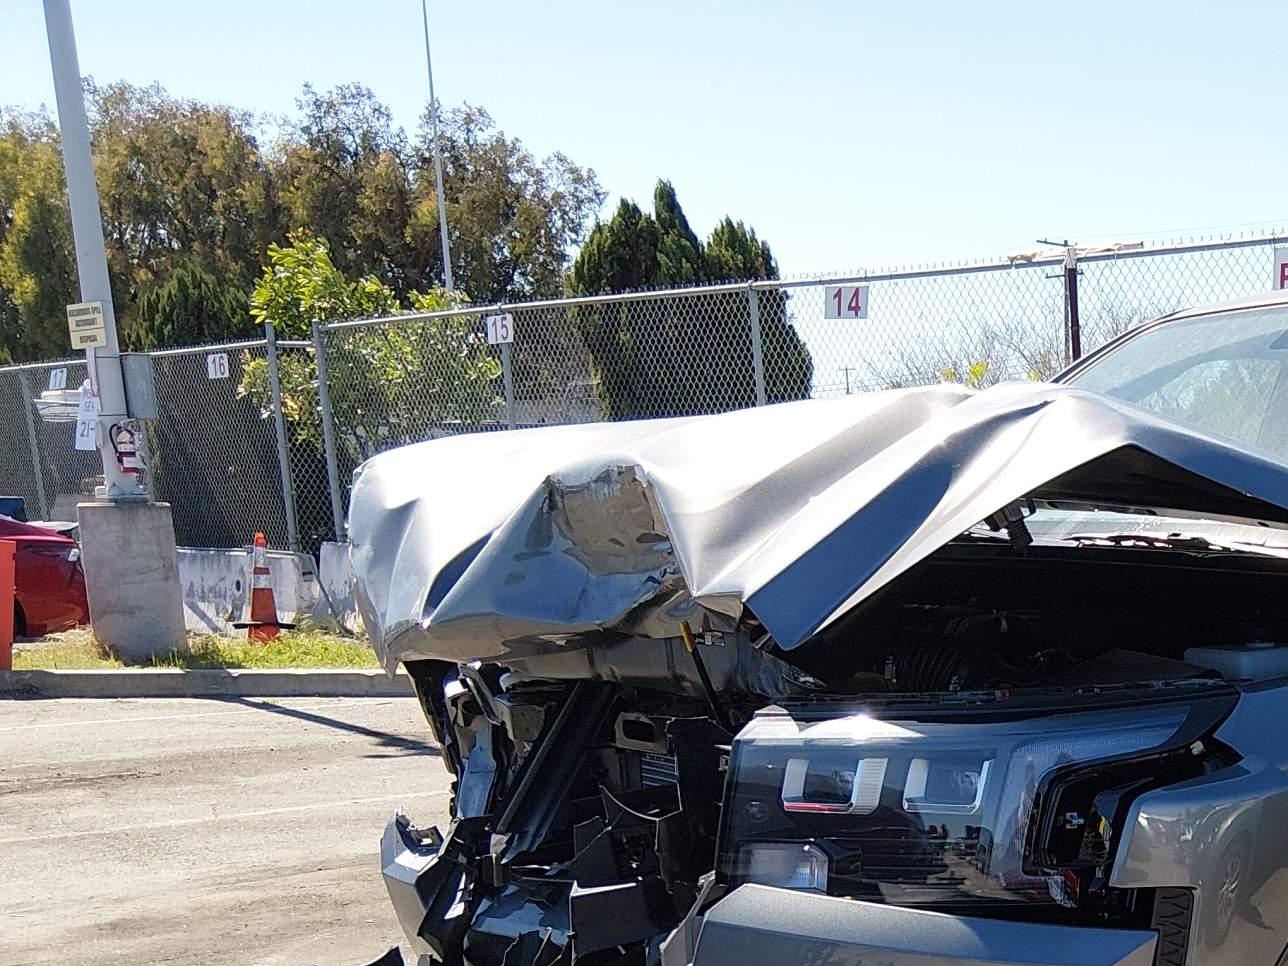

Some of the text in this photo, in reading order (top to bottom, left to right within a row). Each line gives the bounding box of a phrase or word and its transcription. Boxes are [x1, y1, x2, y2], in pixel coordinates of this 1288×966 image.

[832, 287, 861, 317] 14
[491, 316, 509, 342] 15
[52, 369, 65, 388] 17
[212, 355, 226, 378] 16
